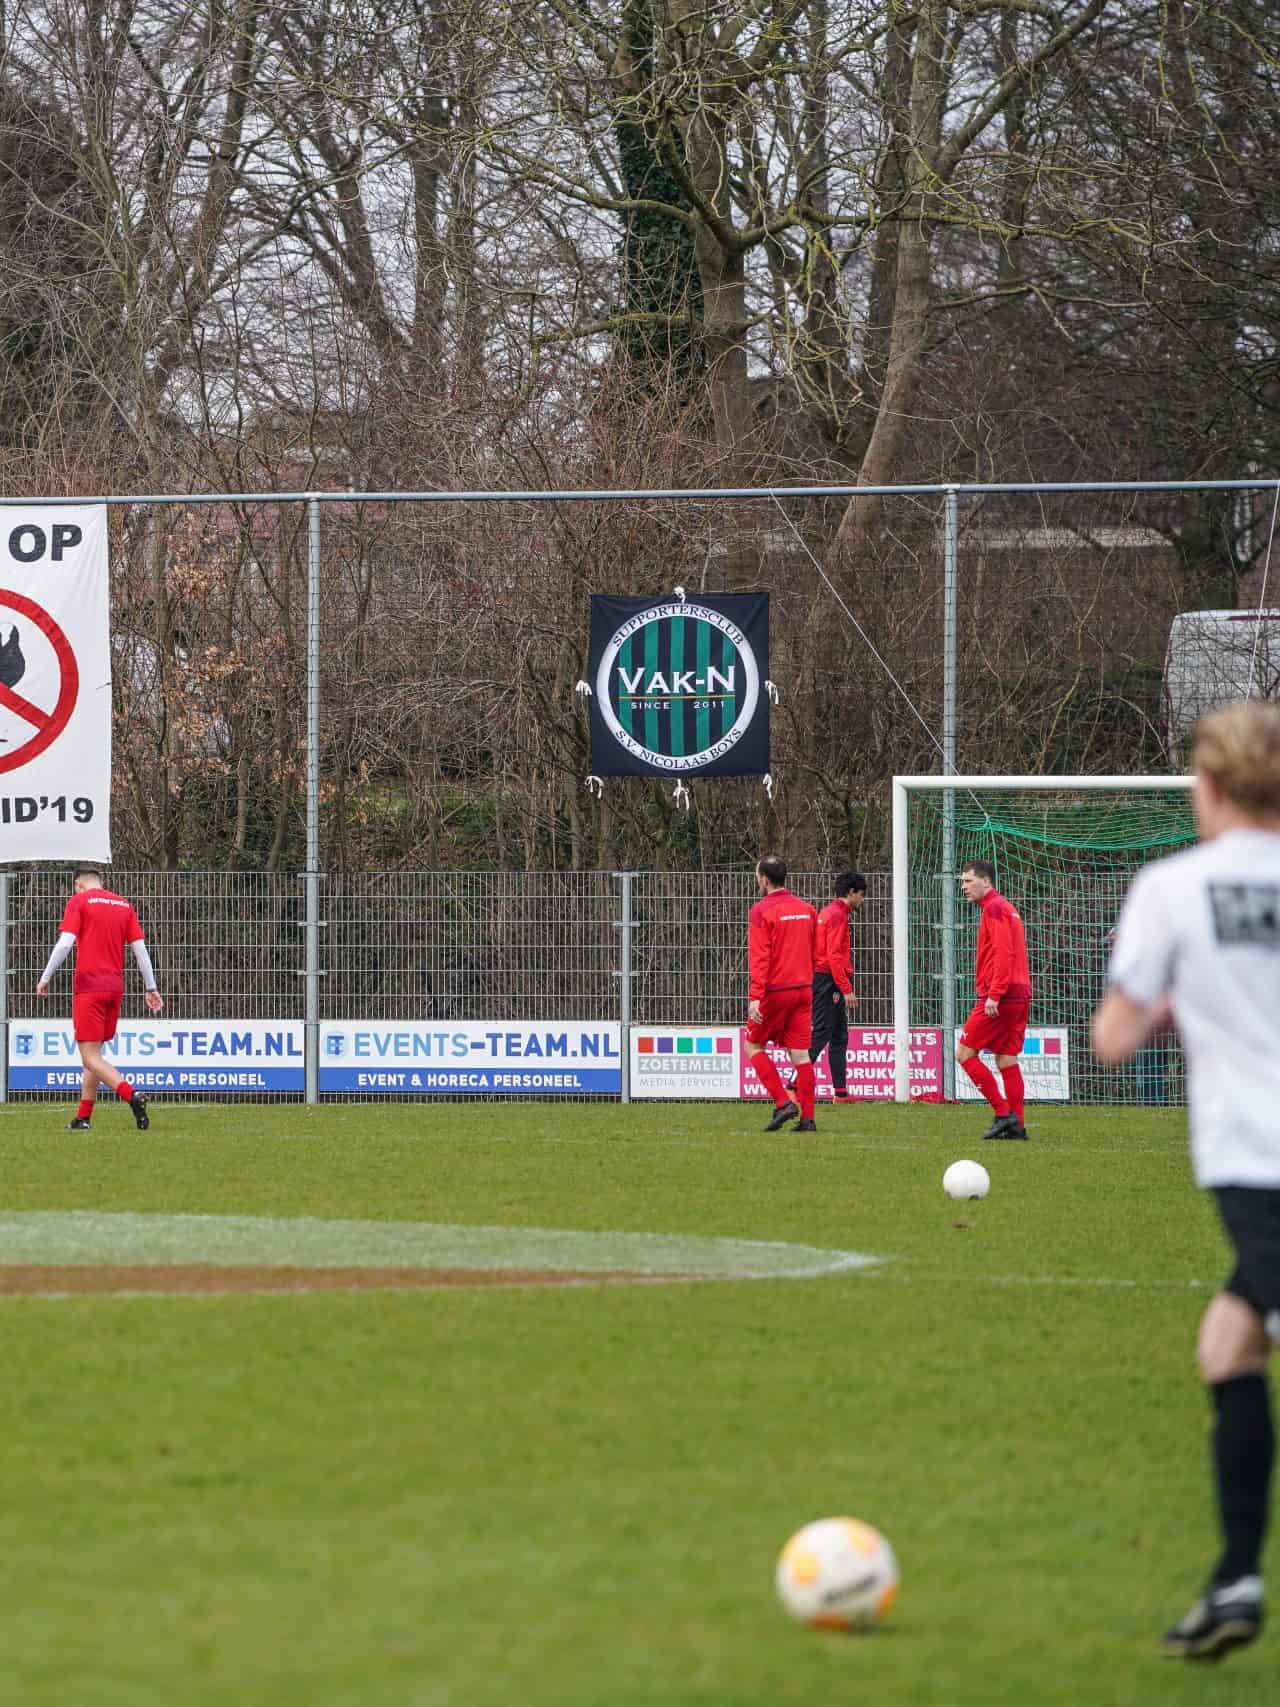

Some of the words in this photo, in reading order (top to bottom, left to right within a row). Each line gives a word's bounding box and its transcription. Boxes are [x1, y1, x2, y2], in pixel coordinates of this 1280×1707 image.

[8, 523, 83, 563] OP
[613, 604, 744, 647] SUPPORTERSCLUB
[631, 702, 671, 710] SINCE
[640, 748, 708, 769] NICOLAAS
[708, 728, 742, 759] BOYS
[43, 1031, 302, 1056] EVNTS-TEAM.NL
[354, 1033, 618, 1057] EVENTS-TEAM.NL
[862, 1032, 937, 1045] EVETS
[639, 1058, 731, 1072] ZOETEMELK
[47, 1072, 84, 1085] EVEN
[122, 1072, 175, 1085] ORECA
[180, 1072, 265, 1085] PERSONEEL
[358, 1074, 405, 1086] EVENT
[411, 1074, 421, 1087] &
[427, 1074, 488, 1087] HORECA
[494, 1074, 581, 1087] PERSONEEL
[639, 1077, 676, 1088] MEDIA
[681, 1077, 731, 1088] SERVICES
